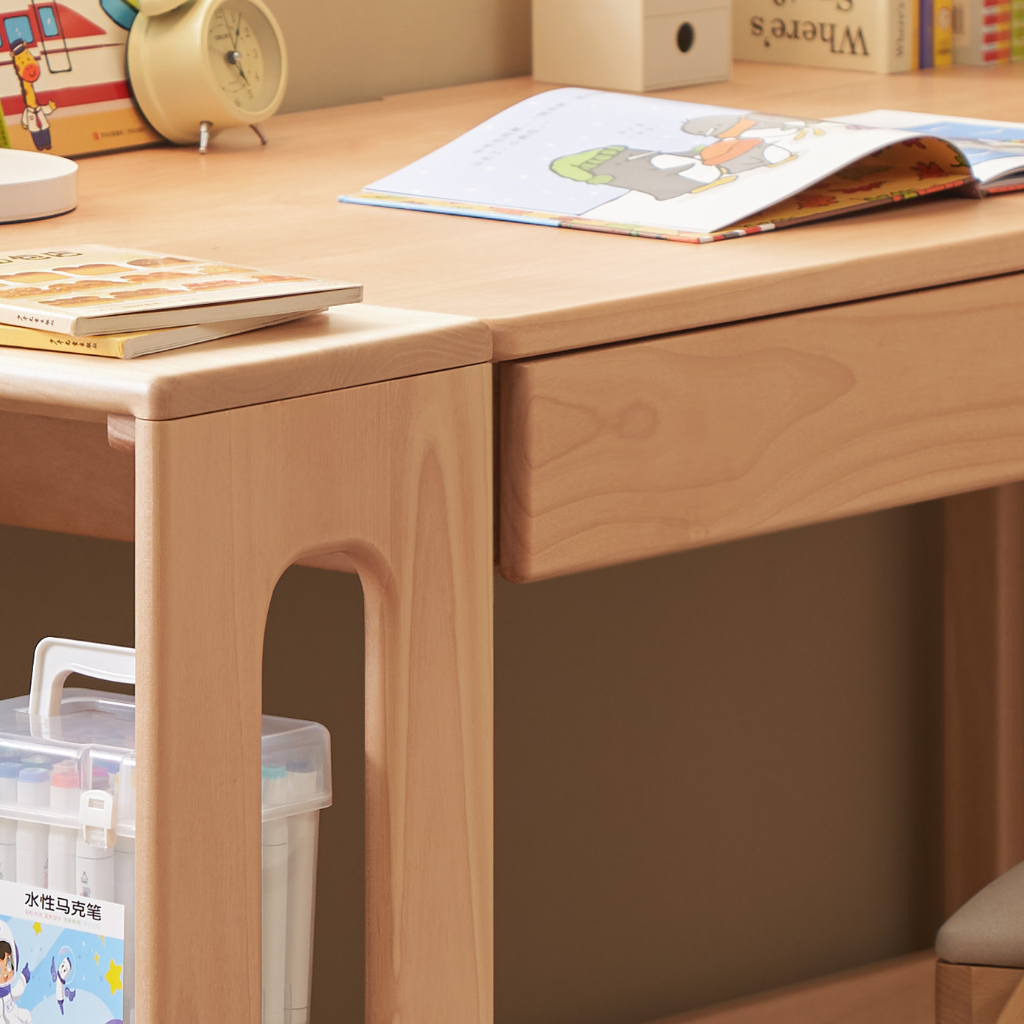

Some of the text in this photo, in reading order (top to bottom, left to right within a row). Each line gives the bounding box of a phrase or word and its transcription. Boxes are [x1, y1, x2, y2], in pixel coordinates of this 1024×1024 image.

[750, 15, 870, 56] Where's
[25, 891, 102, 921] 水性马克笔
